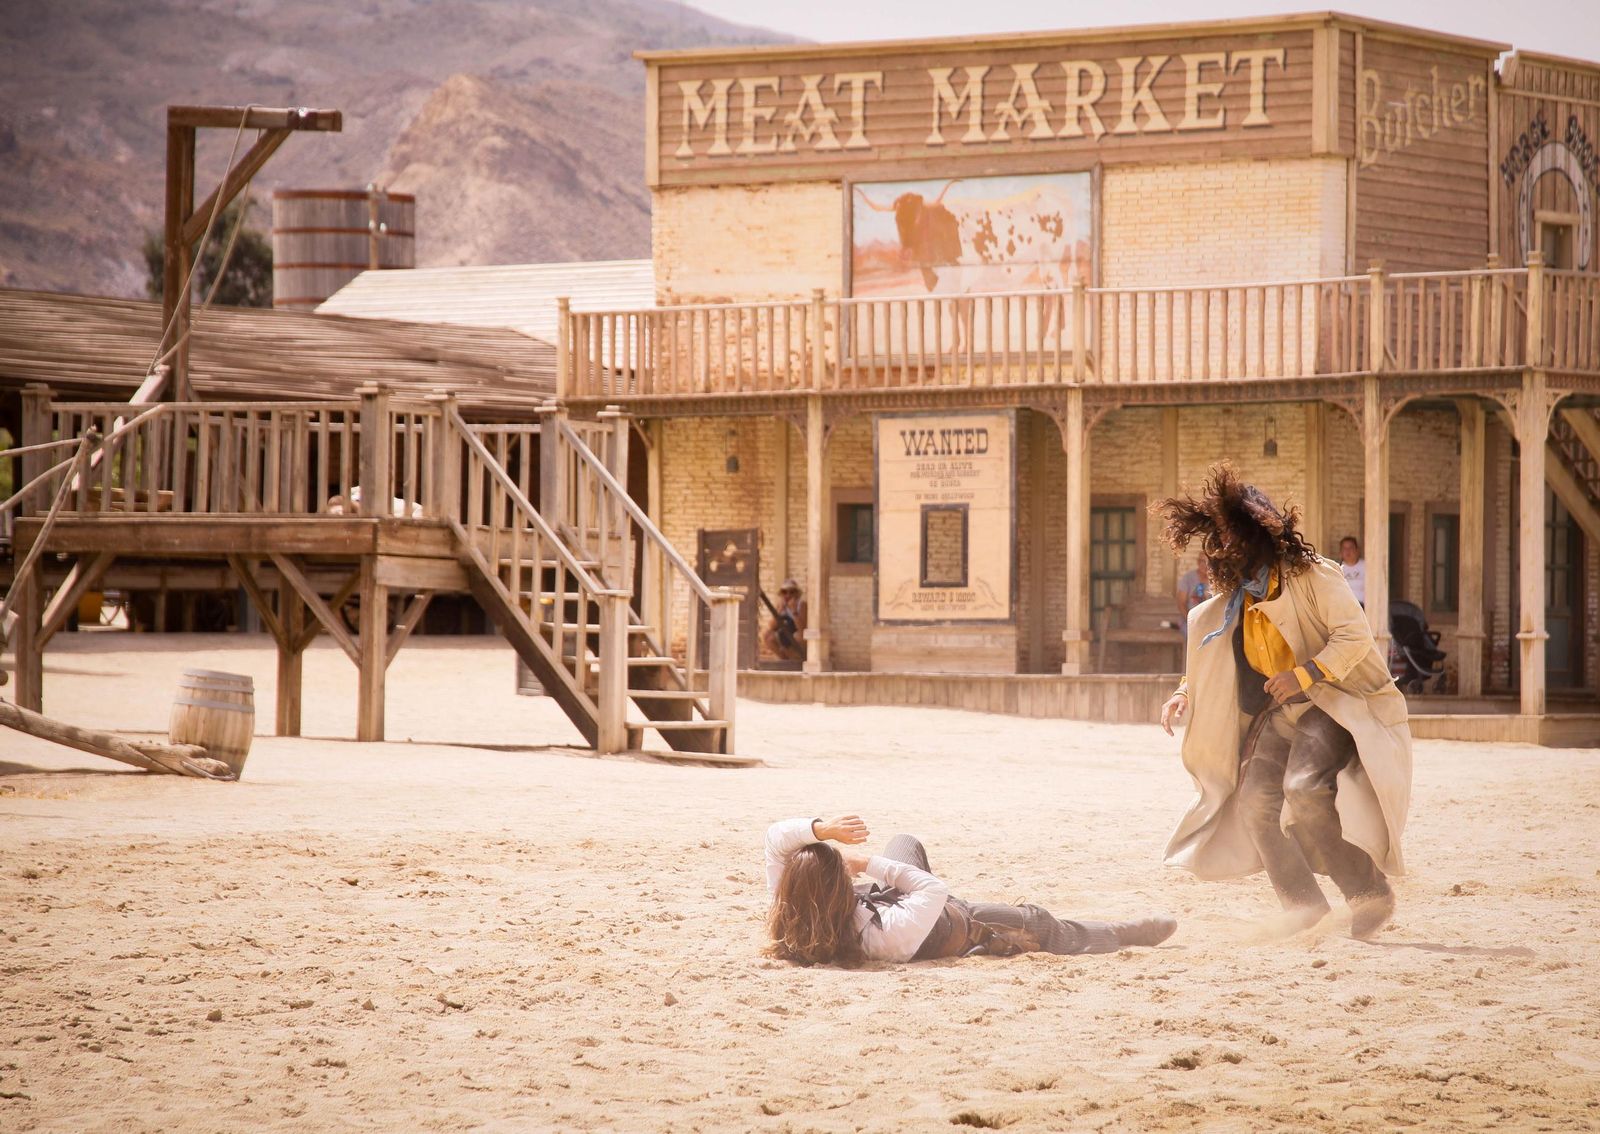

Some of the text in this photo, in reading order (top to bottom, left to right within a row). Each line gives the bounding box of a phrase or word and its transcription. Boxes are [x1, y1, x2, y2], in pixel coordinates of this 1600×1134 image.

[674, 48, 1286, 158] MEAT MARKET
[1359, 65, 1486, 169] Butcher
[900, 427, 989, 456] WANTED
[950, 461, 973, 469] ALIVE
[912, 591, 946, 603] REWARD
